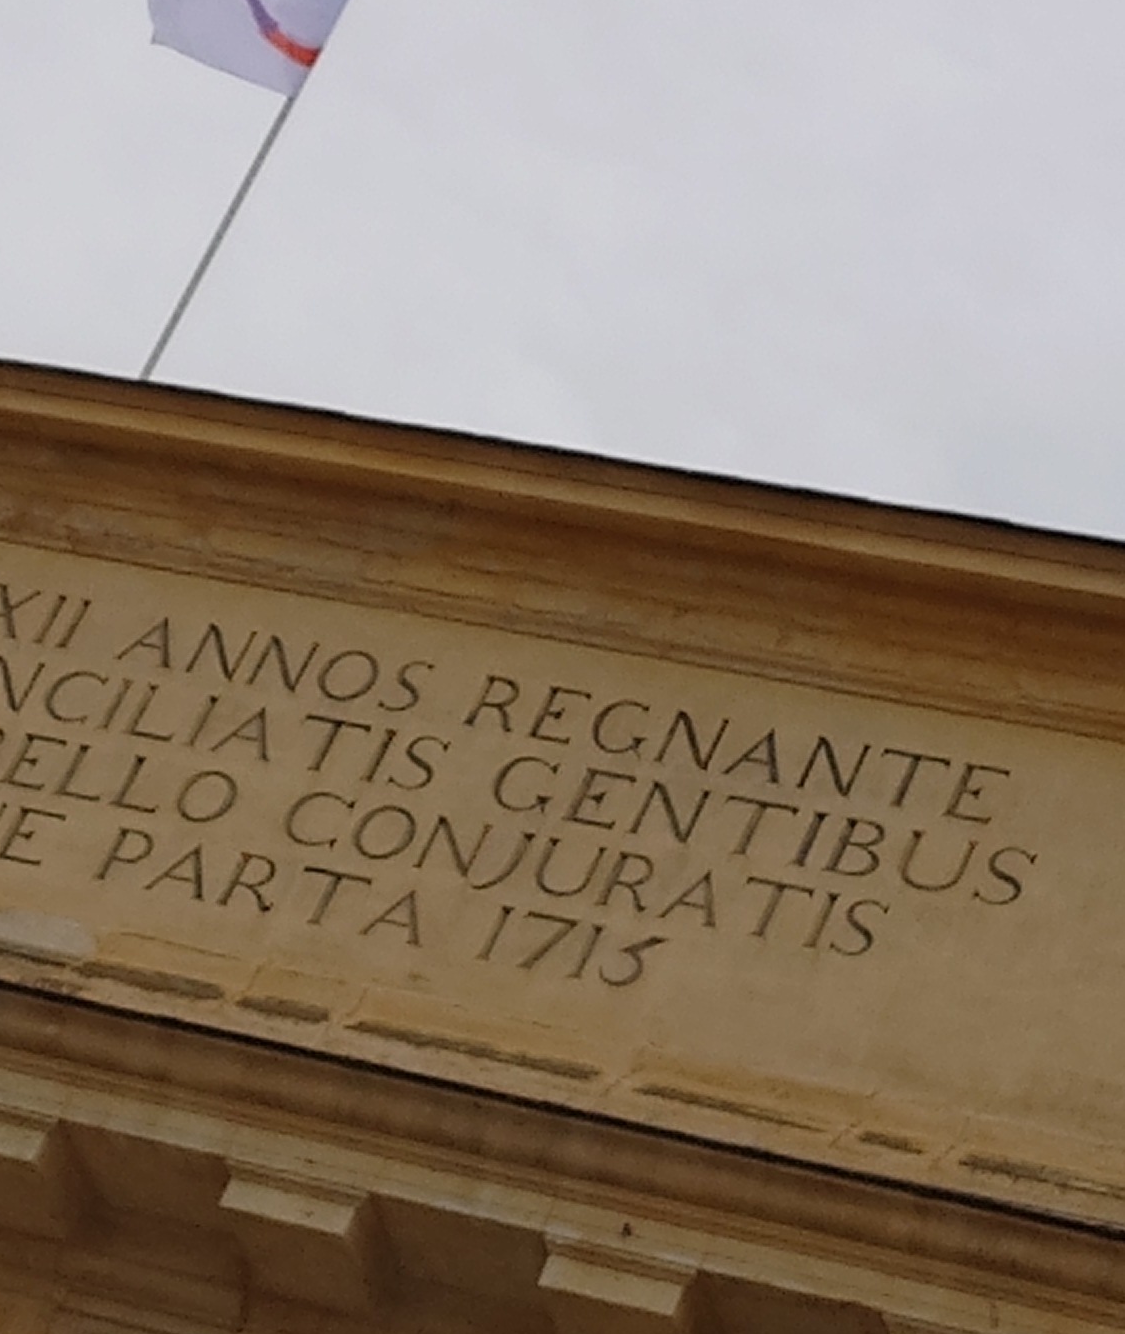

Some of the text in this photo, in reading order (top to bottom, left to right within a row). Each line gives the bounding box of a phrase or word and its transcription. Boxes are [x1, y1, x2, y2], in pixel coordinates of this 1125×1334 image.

[115, 617, 436, 712] ANNOS
[464, 674, 1012, 825] REGNANTE
[95, 828, 423, 948] PARTA
[476, 904, 671, 988] 1715
[285, 791, 890, 957] CONJURATIS
[493, 756, 1038, 906] GENTIBUS
